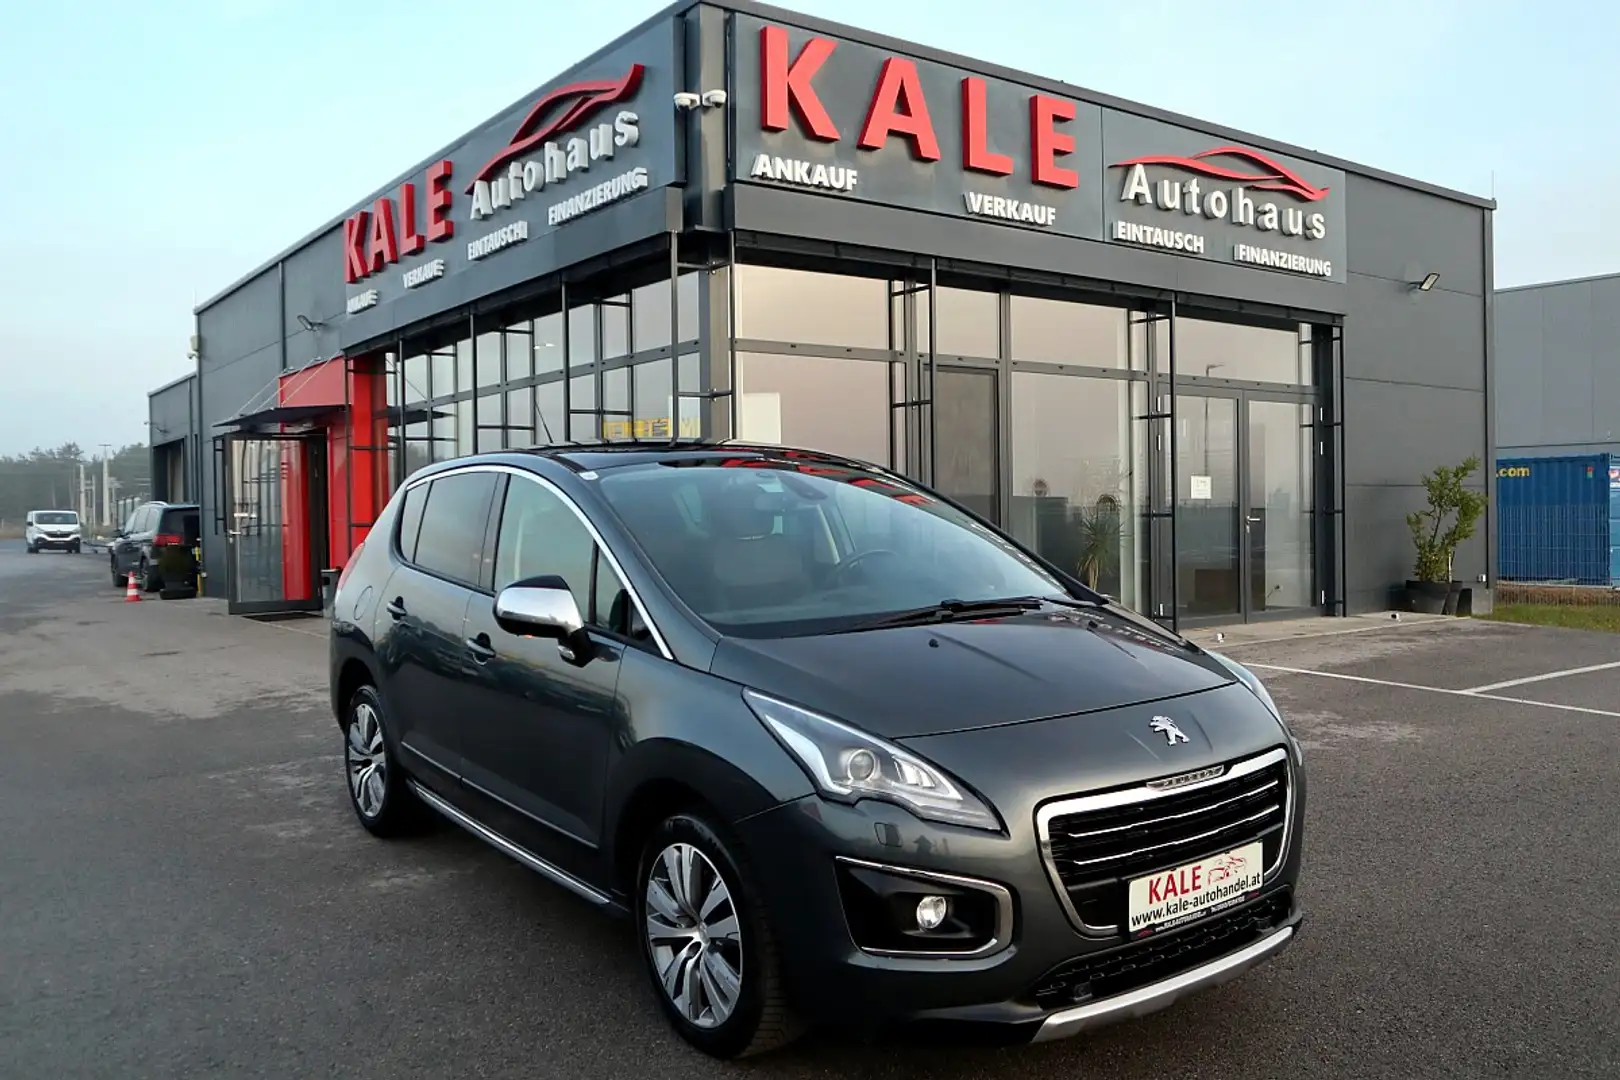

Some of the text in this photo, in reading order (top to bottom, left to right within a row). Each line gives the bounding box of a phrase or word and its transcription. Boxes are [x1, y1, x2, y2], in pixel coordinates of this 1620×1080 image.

[760, 25, 1079, 189] KALE
[470, 111, 640, 220] Autohaus
[751, 154, 858, 191] ANKAUF
[548, 167, 648, 226] FINANZIERUNG
[963, 192, 1056, 226] VERKAUF
[1121, 163, 1326, 239] Autohaus
[343, 160, 453, 284] KALE
[467, 221, 528, 260] EINTAUSCH
[1112, 220, 1205, 253] EINTAUSCH
[1233, 244, 1332, 277] FINANZIERUNG
[1131, 872, 1261, 927] www.kale-autohandel.at
[1148, 865, 1202, 905] KALE
